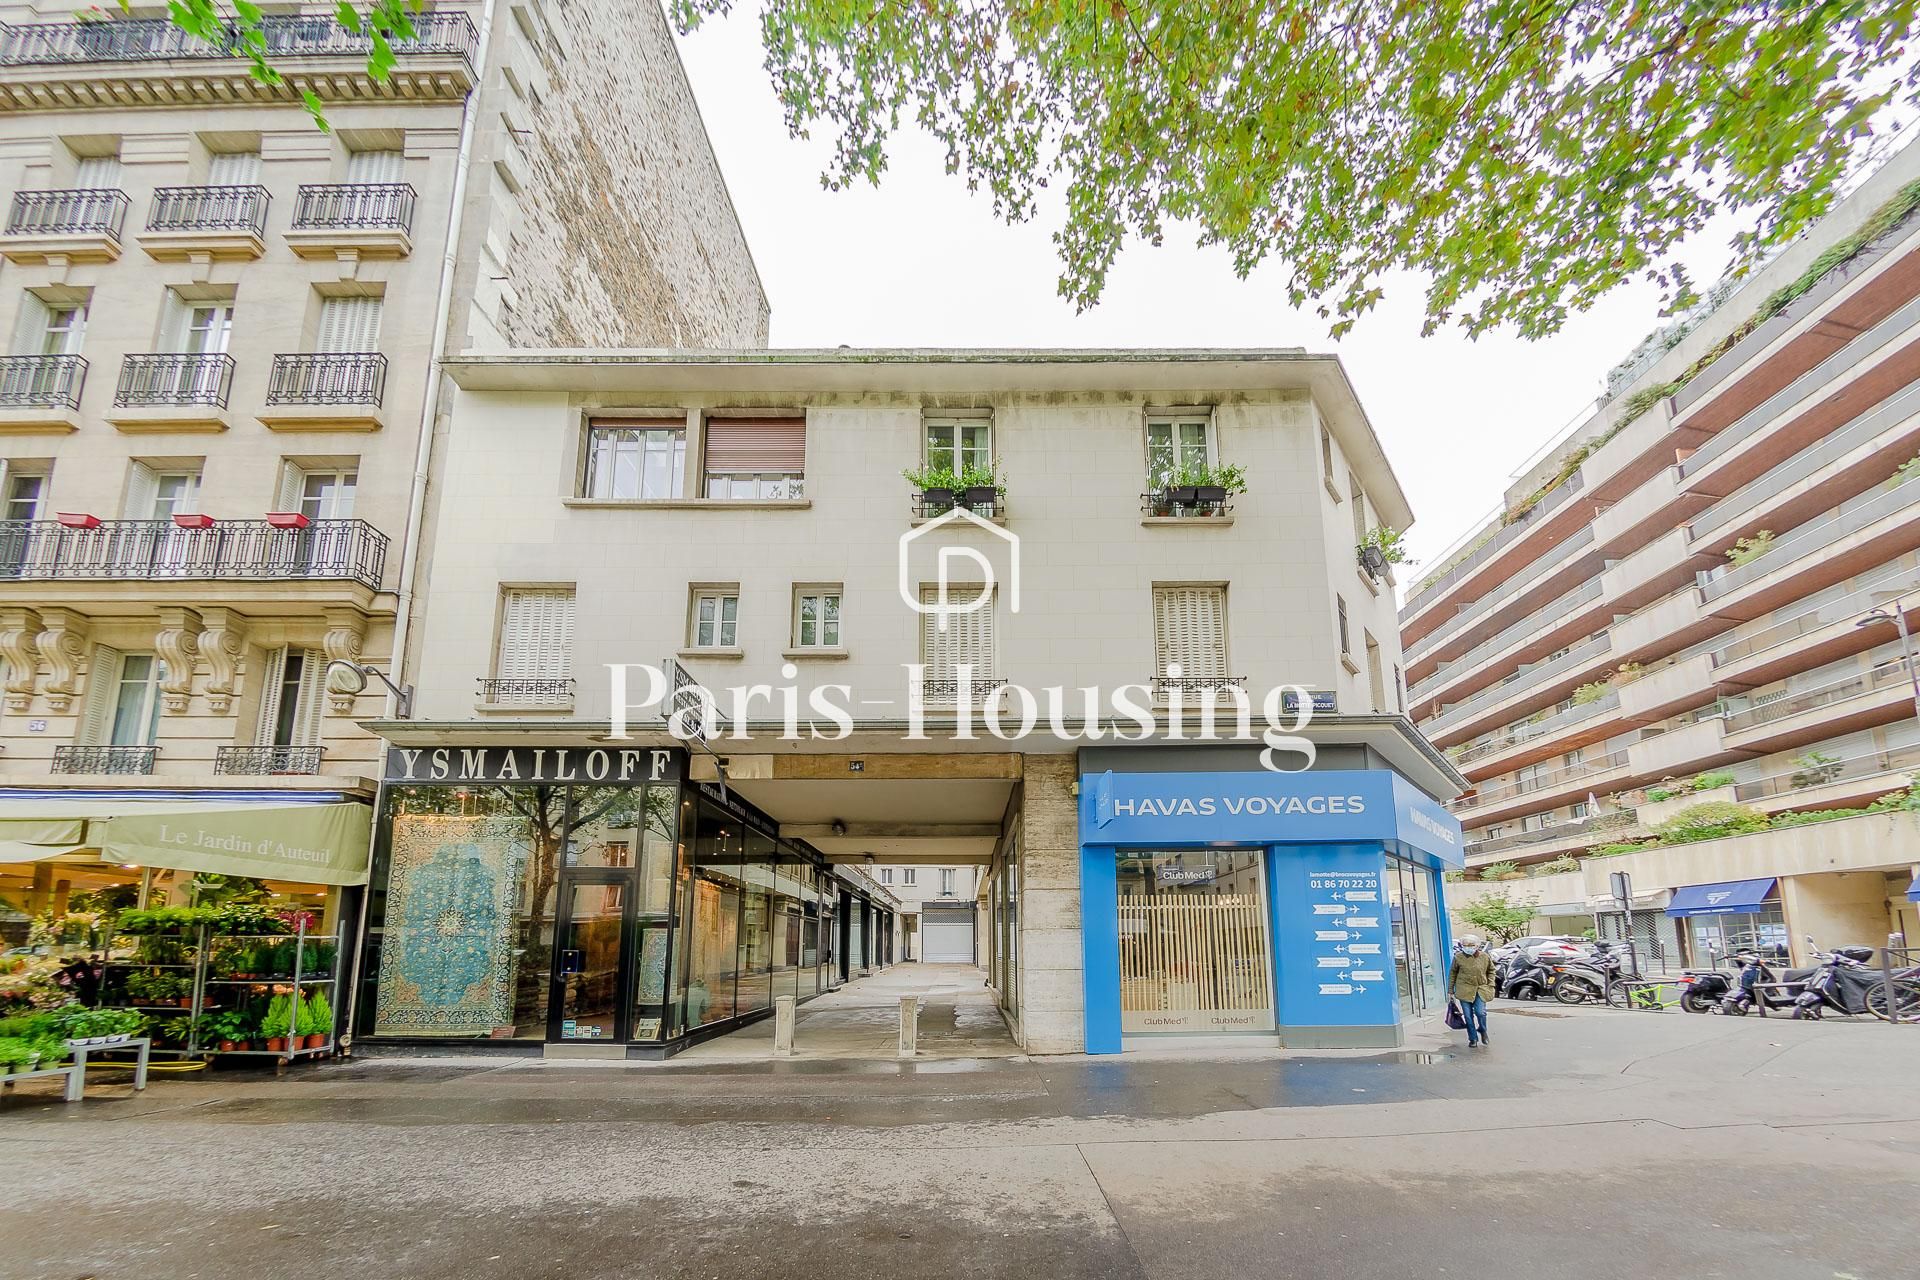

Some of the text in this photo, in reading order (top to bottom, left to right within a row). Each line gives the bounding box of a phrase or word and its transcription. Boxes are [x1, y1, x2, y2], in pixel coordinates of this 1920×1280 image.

[399, 748, 671, 781] YSMAILOFF
[1114, 797, 1217, 817] HAVAS
[1223, 795, 1366, 816] VOYAGES
[159, 824, 331, 865] Le Jardin d'Auteuil
[1310, 880, 1377, 889] 01 86 70 22 20
